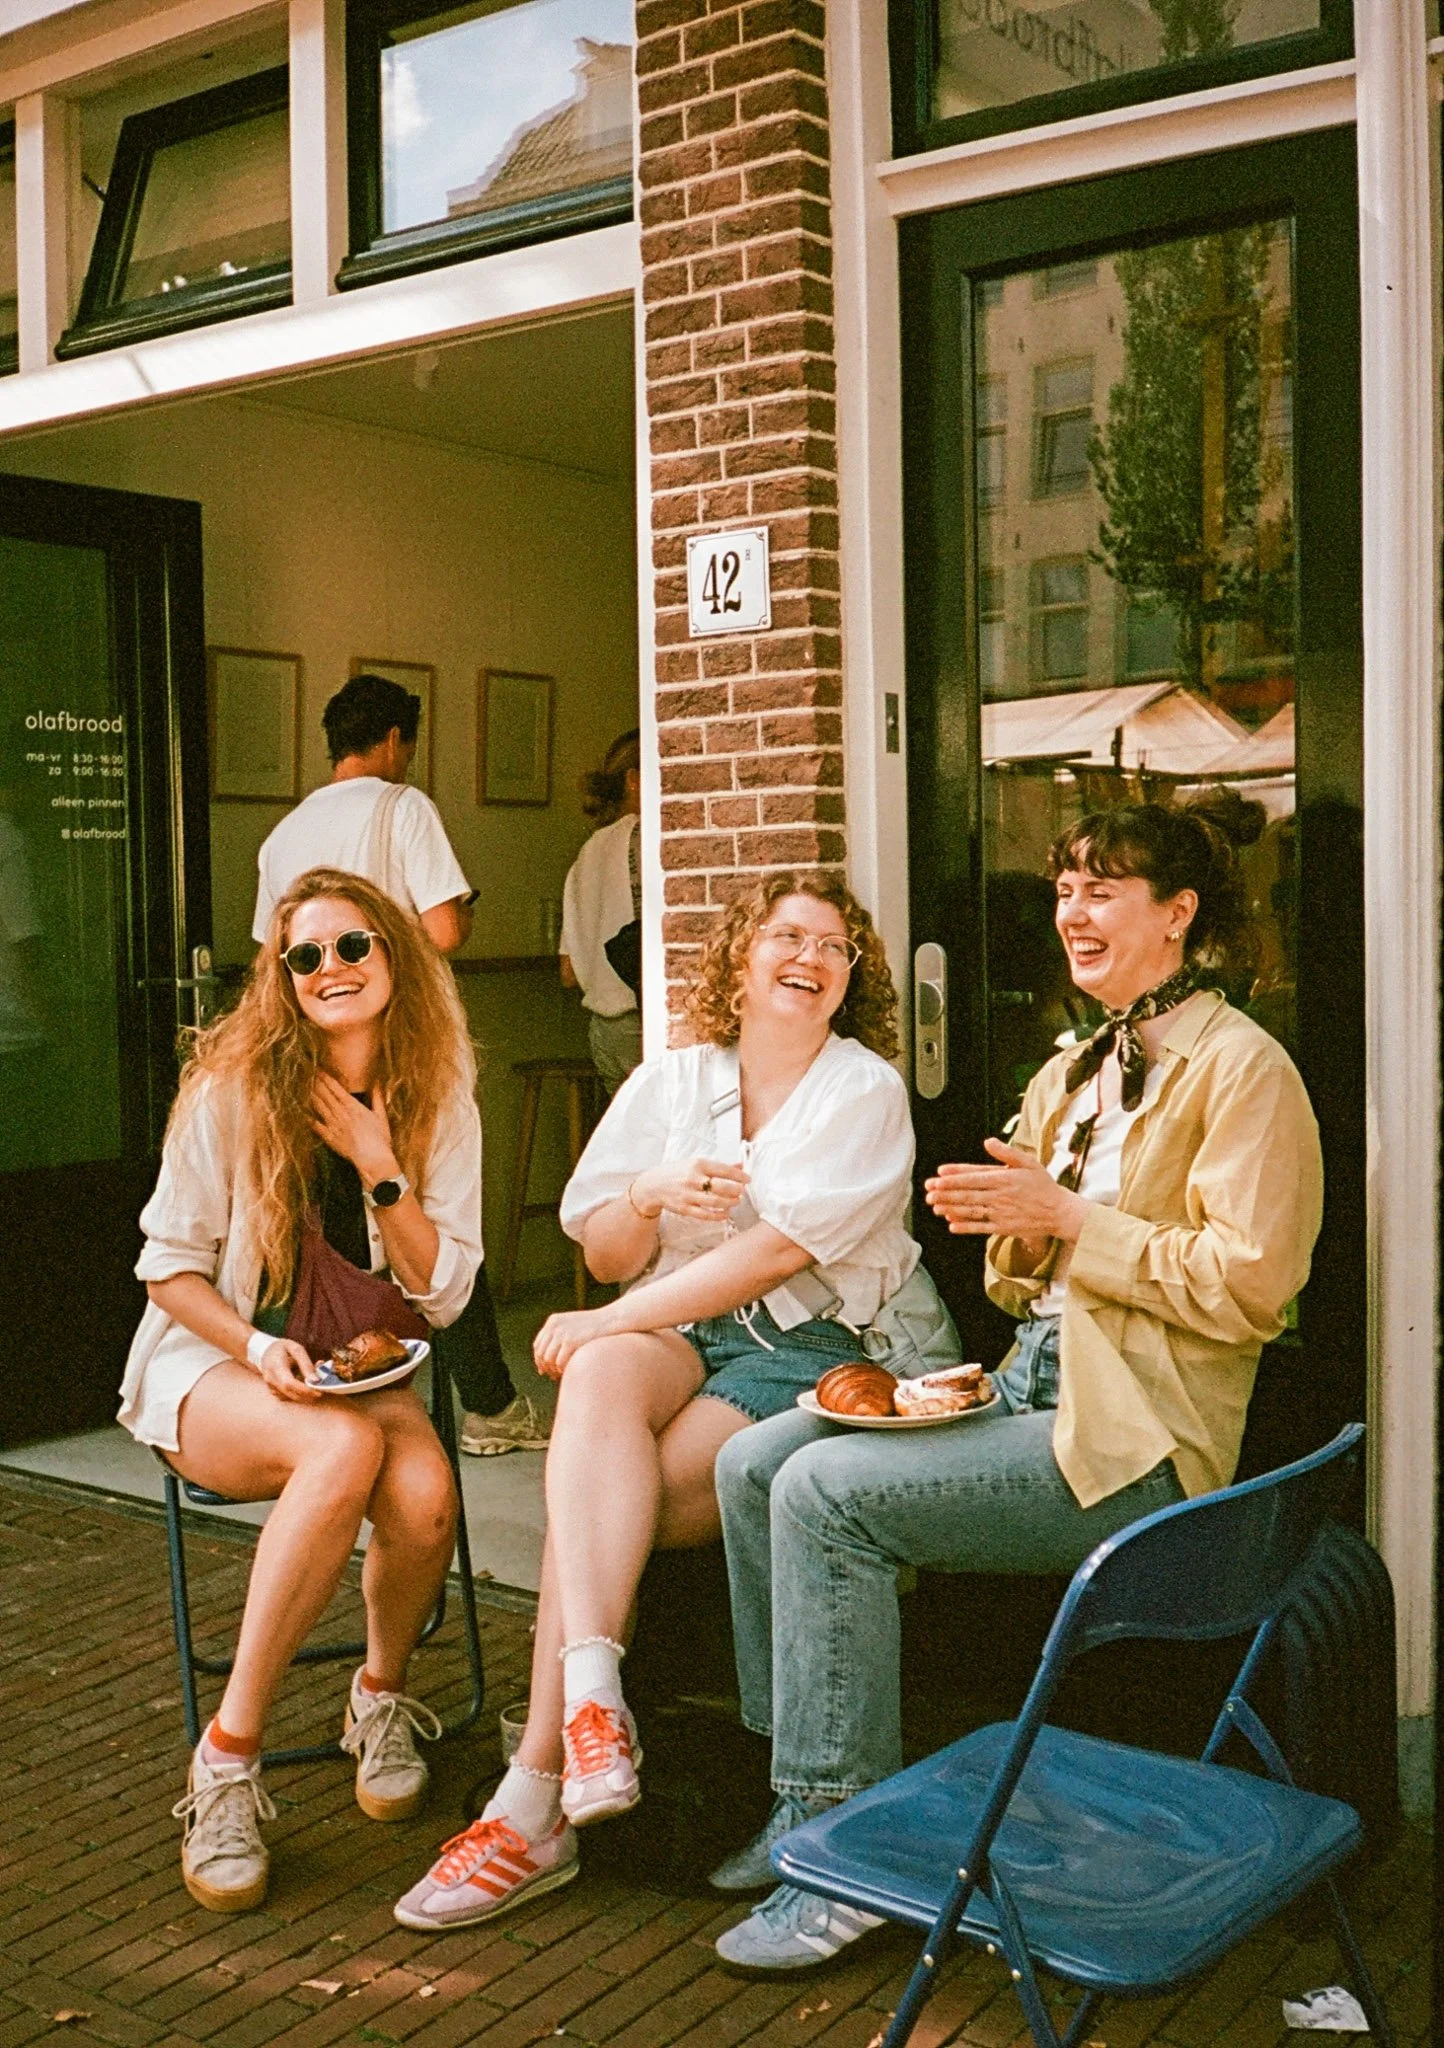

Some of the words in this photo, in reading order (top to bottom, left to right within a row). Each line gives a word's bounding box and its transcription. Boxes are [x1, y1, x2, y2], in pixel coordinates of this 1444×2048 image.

[702, 551, 742, 614] 42
[25, 710, 122, 733] olafbrood
[48, 766, 62, 775] za
[51, 796, 85, 808] alleen
[88, 799, 125, 809] pinnen
[72, 828, 126, 839] olafbrood
